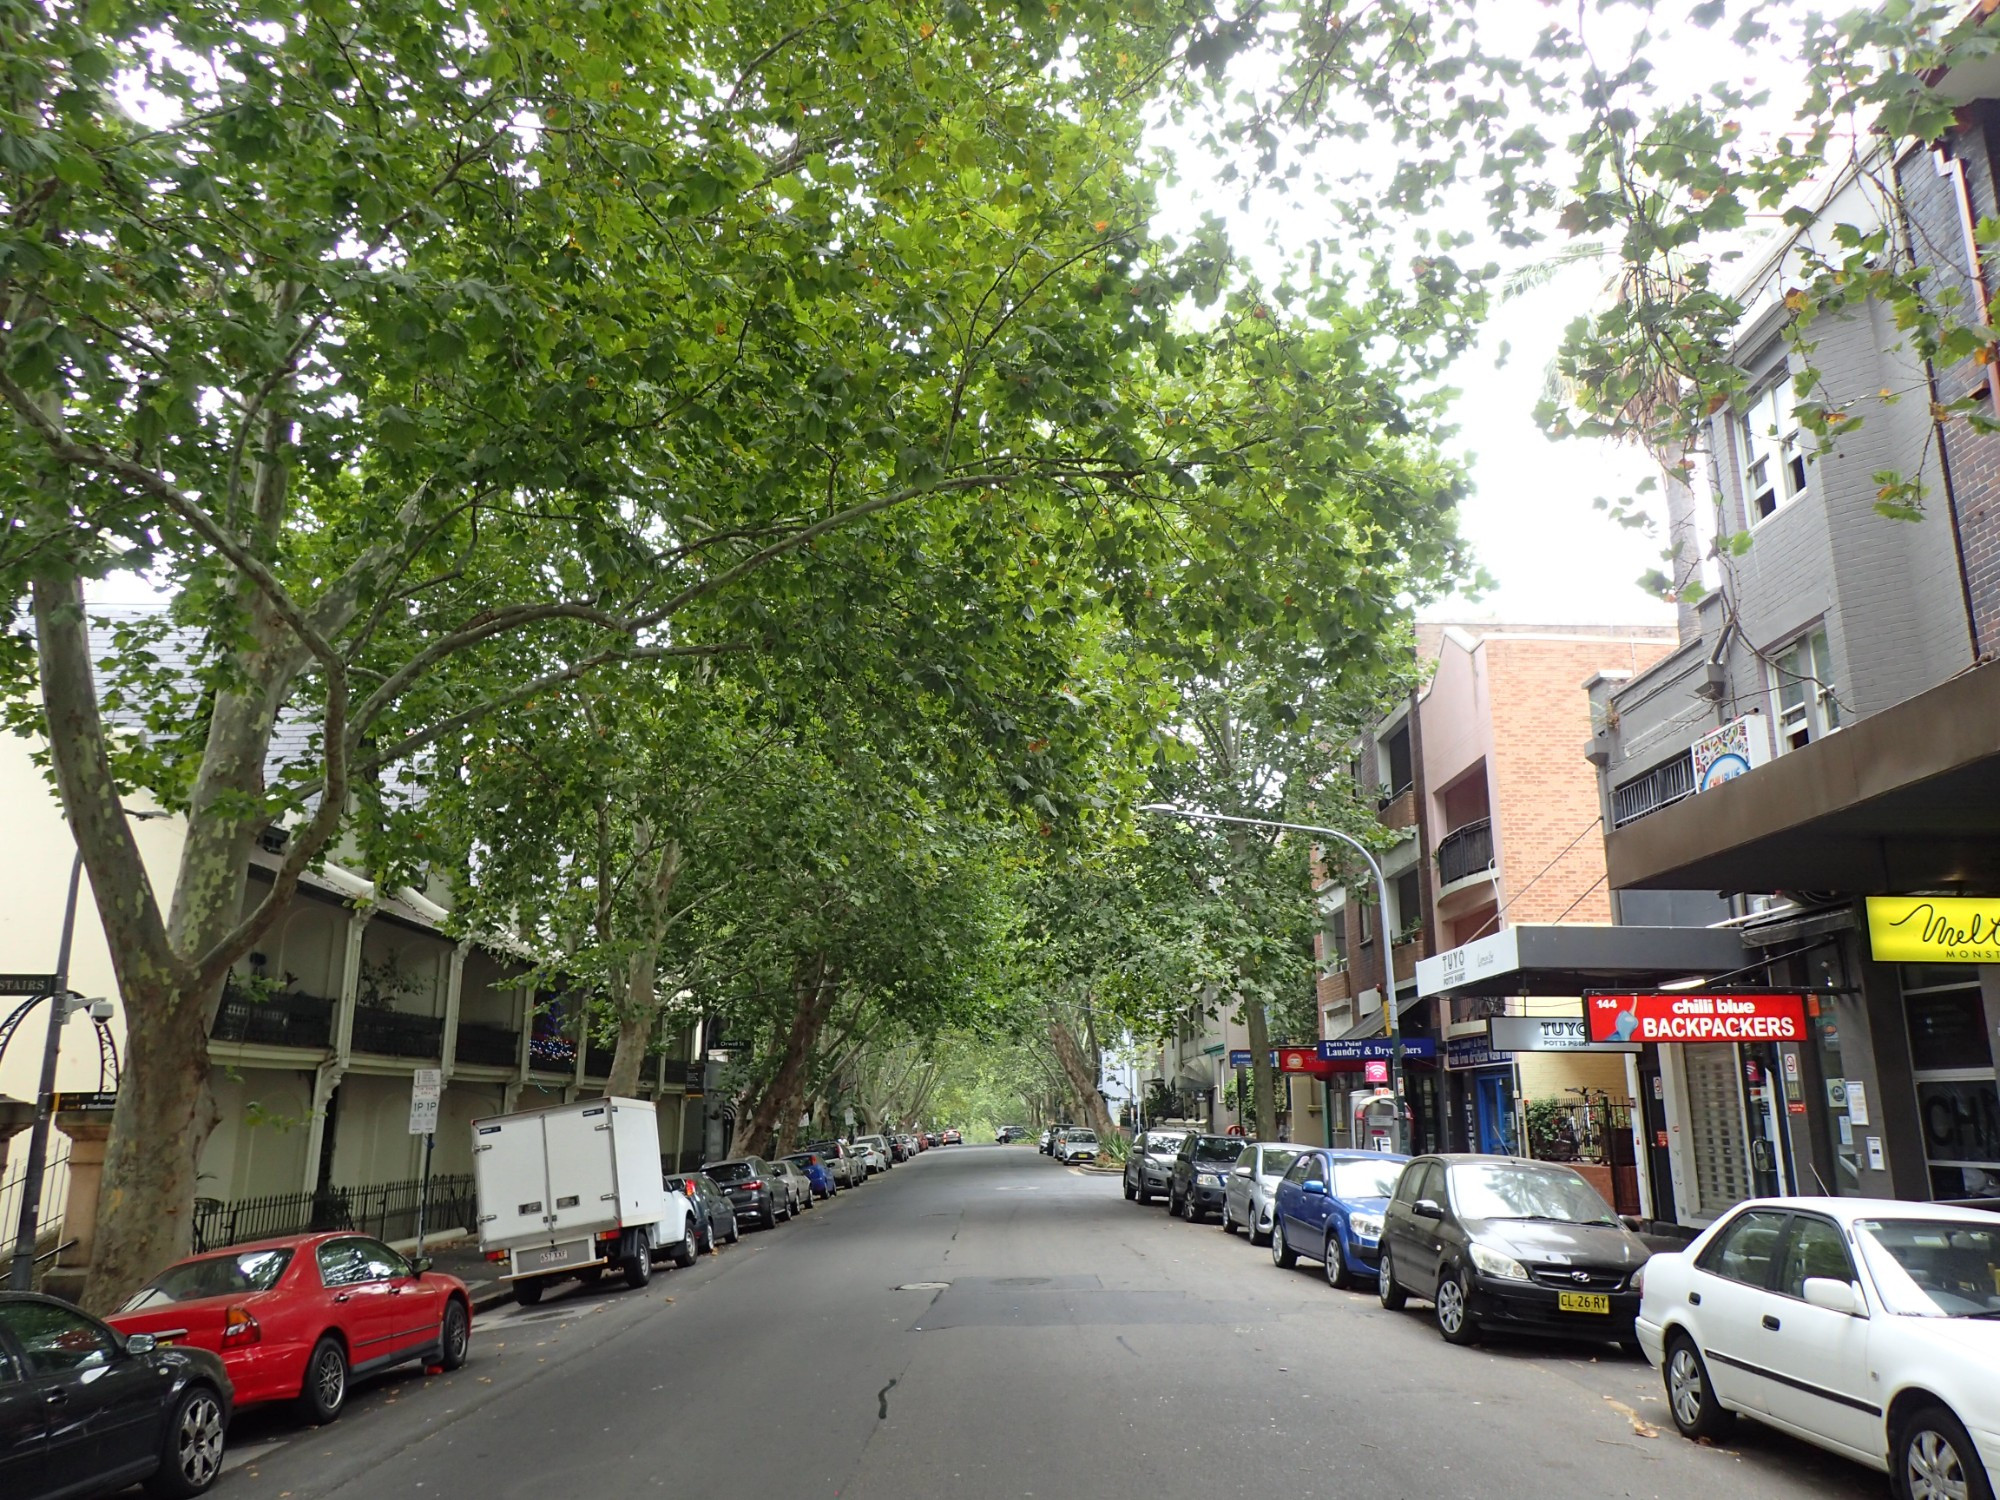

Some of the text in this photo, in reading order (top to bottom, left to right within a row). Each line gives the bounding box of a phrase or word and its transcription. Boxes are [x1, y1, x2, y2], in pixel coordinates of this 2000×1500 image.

[1442, 950, 1465, 971] TUYO
[1597, 999, 1617, 1009] 144
[1672, 999, 1755, 1014] chilli blue
[1642, 1017, 1795, 1037] BACKPACKERS
[1326, 1047, 1361, 1057] Laundry
[1364, 1046, 1372, 1055] &
[414, 1101, 437, 1112] 1P 1P
